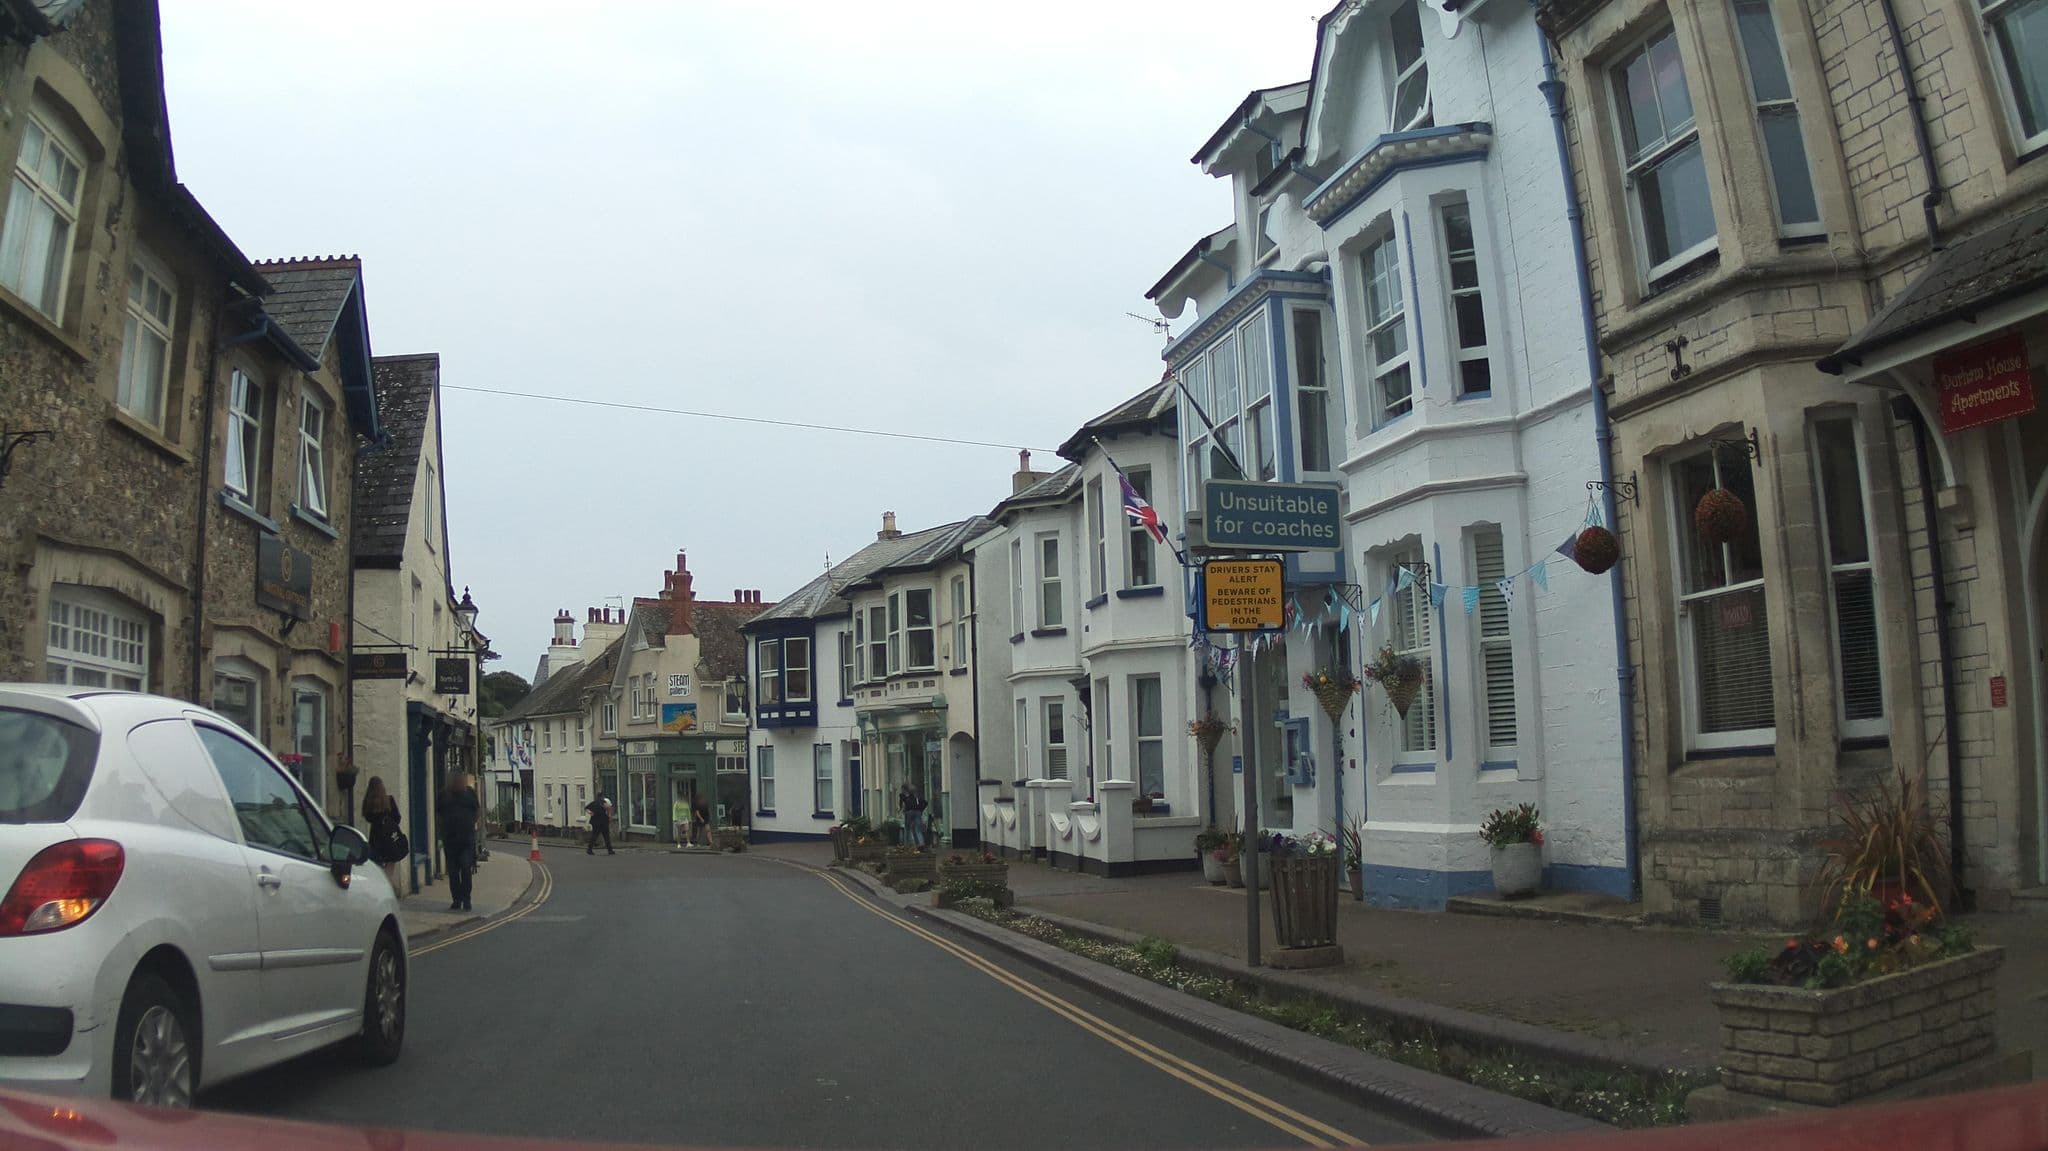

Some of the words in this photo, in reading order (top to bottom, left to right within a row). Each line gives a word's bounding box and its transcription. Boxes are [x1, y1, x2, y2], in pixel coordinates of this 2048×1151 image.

[1986, 354, 2022, 381] House
[1951, 379, 2021, 415] Apartments
[1220, 491, 1328, 514] Unsuitable
[1215, 515, 1244, 534] for
[1252, 519, 1334, 538] coaches
[1210, 566, 1250, 574] DRIVERS
[1253, 566, 1276, 574] STAY
[1229, 575, 1258, 583] ALERT
[1217, 588, 1256, 596] BEWARE
[1258, 588, 1271, 596] OF
[1212, 597, 1277, 606] PEDESTRIANS
[1230, 607, 1241, 615] IN
[1243, 607, 1261, 615] THE
[1232, 616, 1258, 625] ROAD
